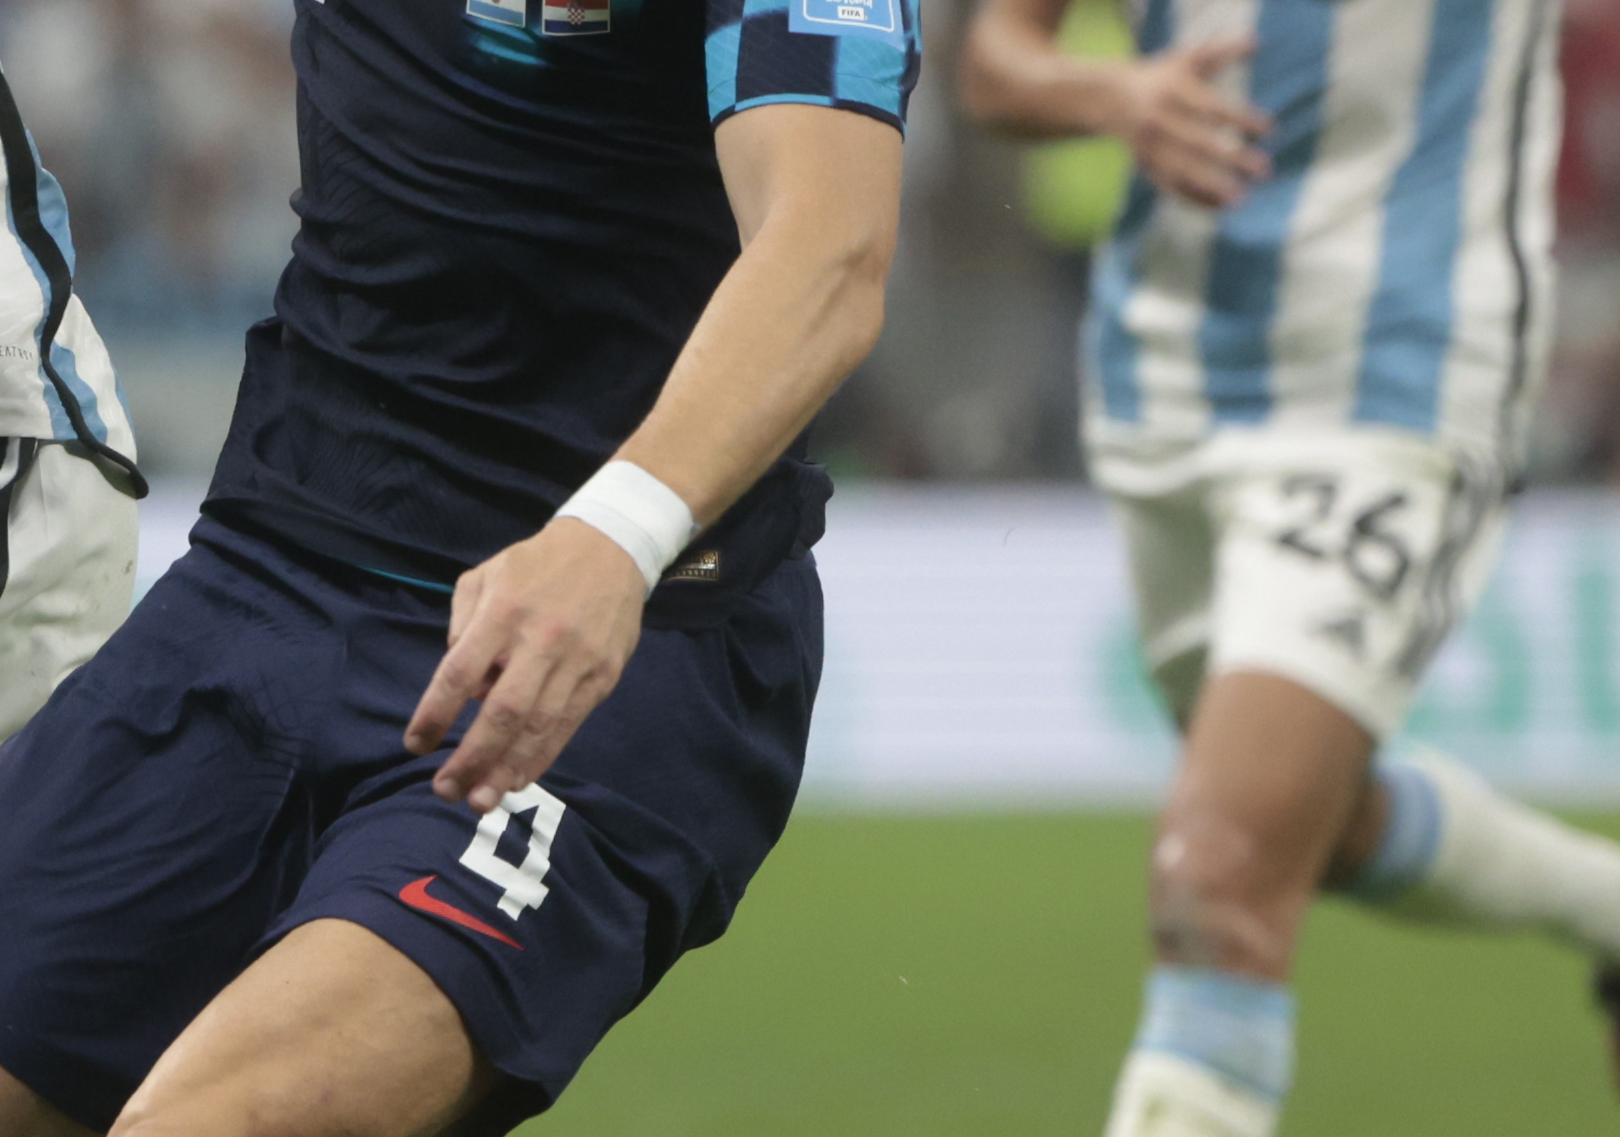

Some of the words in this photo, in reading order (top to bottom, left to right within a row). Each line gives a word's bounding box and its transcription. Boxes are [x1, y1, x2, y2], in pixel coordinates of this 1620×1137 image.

[841, 9, 861, 17] FIFA
[1273, 471, 1412, 604] 26
[458, 781, 567, 921] 4
